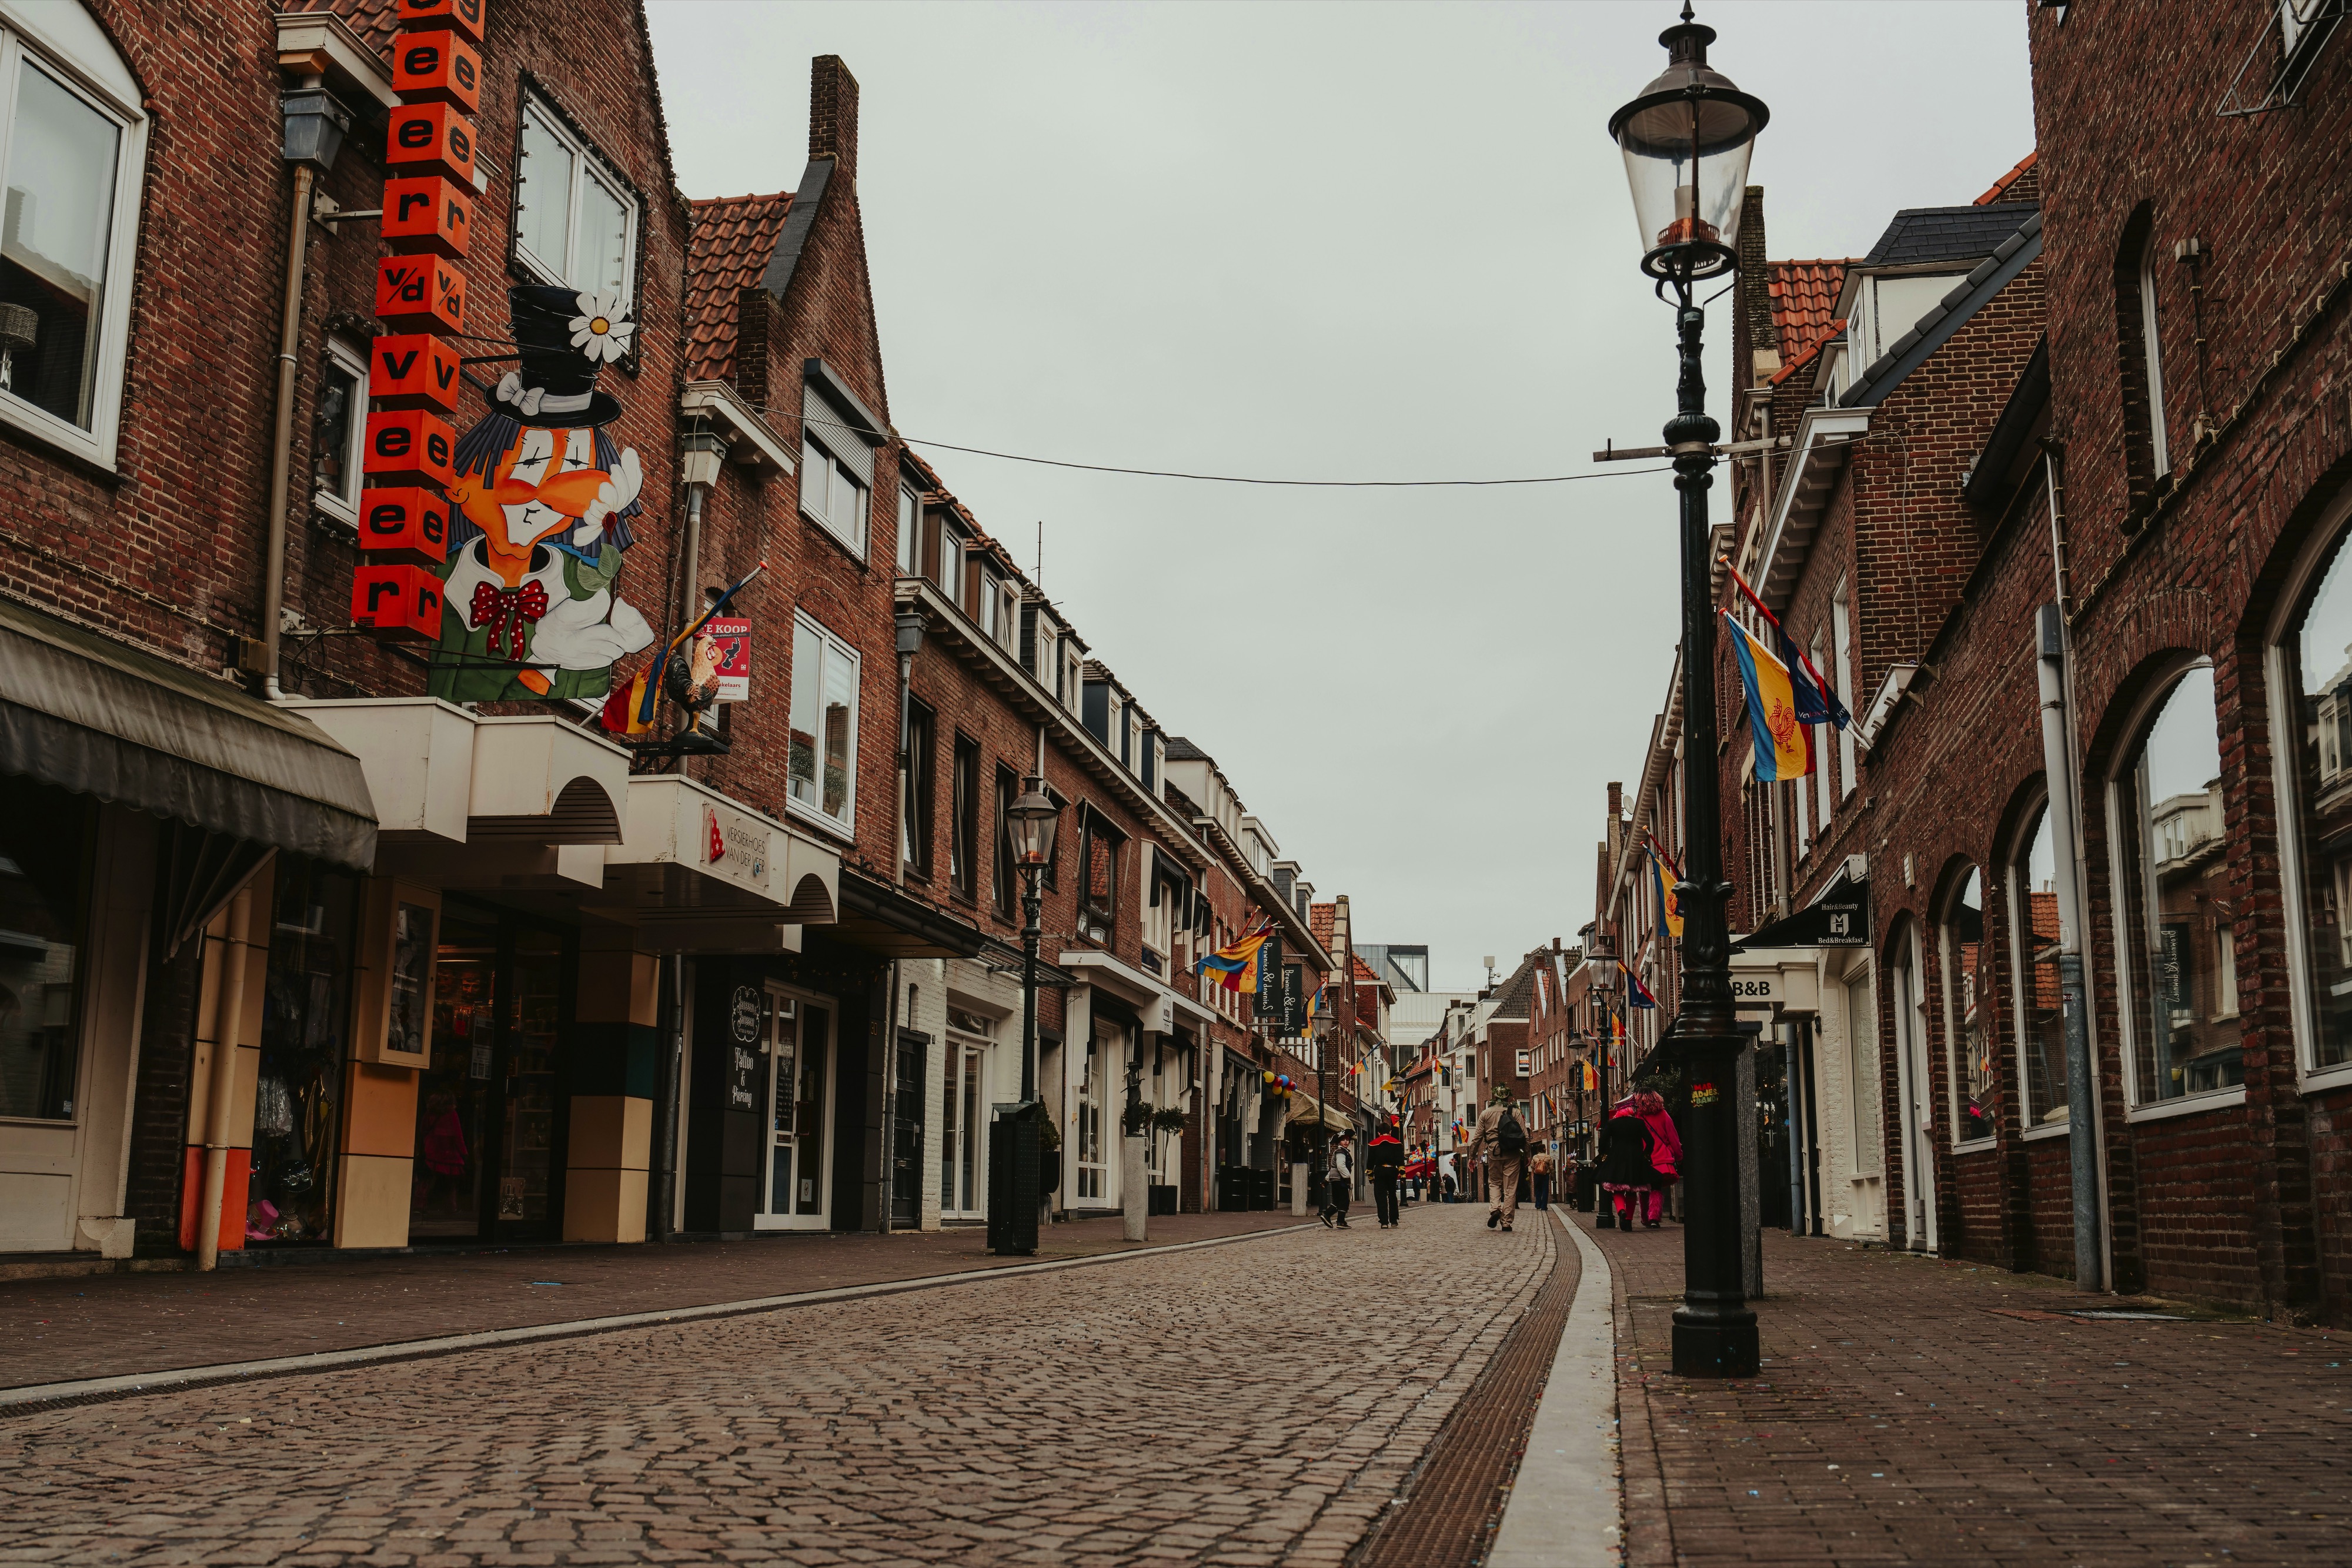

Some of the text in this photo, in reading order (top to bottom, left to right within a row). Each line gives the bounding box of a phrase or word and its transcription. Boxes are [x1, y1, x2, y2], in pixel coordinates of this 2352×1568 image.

[716, 624, 748, 634] KOOP
[727, 825, 765, 854] VERSIERHOES
[726, 844, 739, 862] VAN
[740, 851, 751, 867] DER
[1732, 981, 1770, 996] B&B
[734, 1047, 753, 1071] Tattoo
[741, 1071, 746, 1086] &
[732, 1085, 752, 1108] Piercing
[1692, 1088, 1717, 1099] ADJES
[1696, 1095, 1716, 1104] BAND
